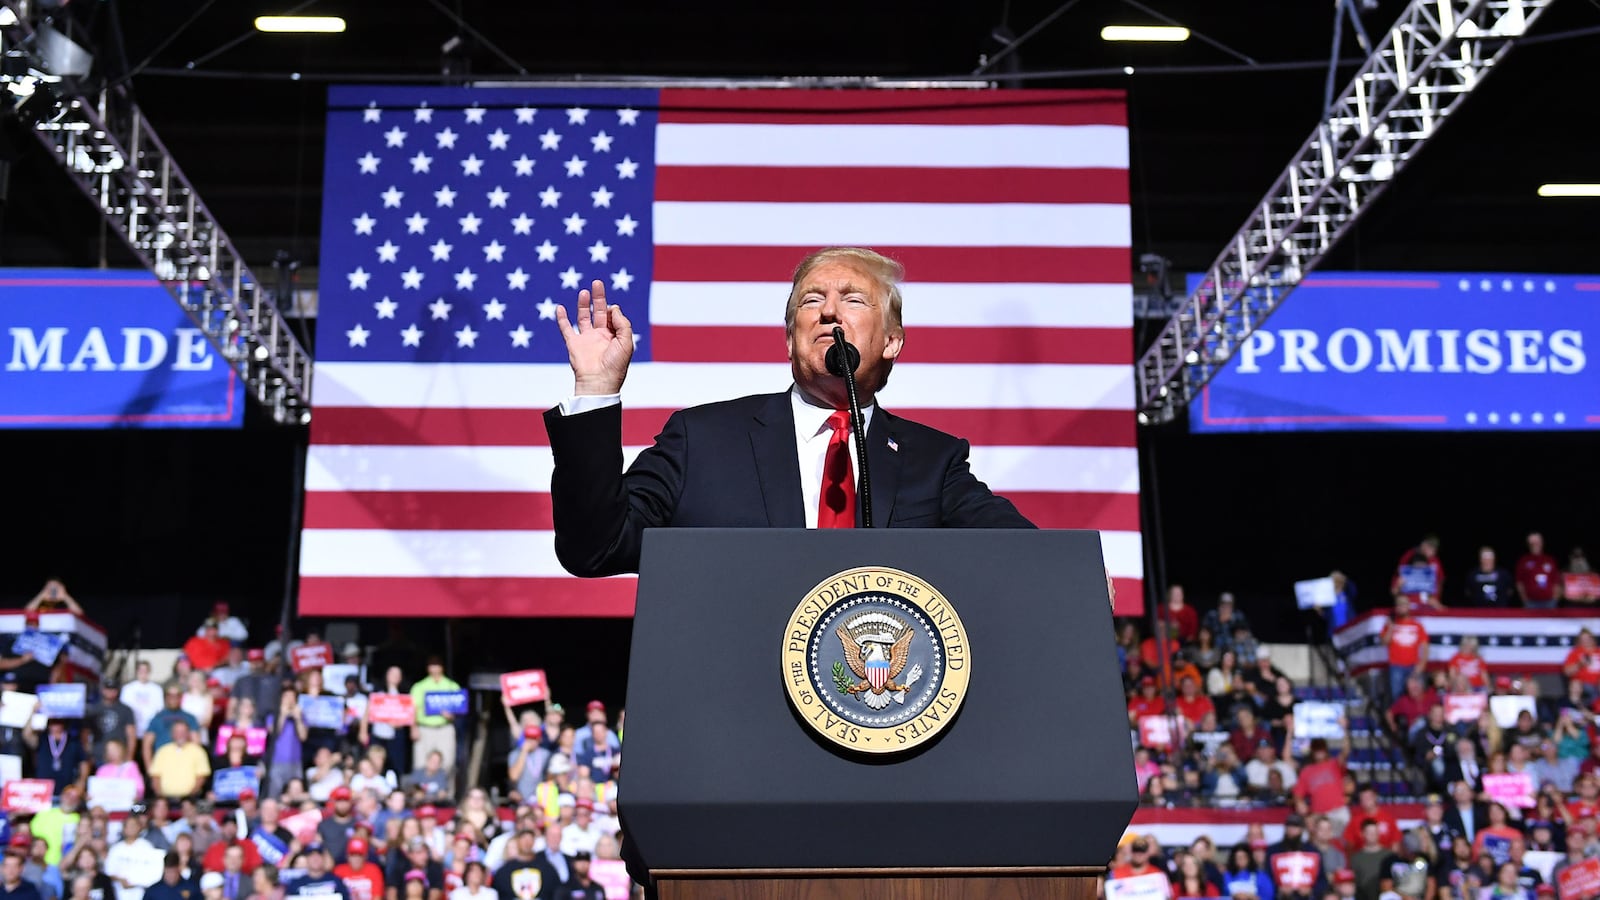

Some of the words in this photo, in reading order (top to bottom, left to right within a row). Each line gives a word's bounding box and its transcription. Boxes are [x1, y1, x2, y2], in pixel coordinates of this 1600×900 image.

[5, 327, 213, 372] MADE
[1236, 327, 1587, 375] PROMISES
[876, 576, 894, 588] OF
[897, 580, 921, 598] THE
[789, 574, 871, 654] PRESIDENT
[924, 595, 964, 671] UNITED
[791, 660, 805, 687] THE
[798, 690, 814, 705] OF
[895, 688, 957, 744] STATES
[813, 704, 861, 743] SEAL
